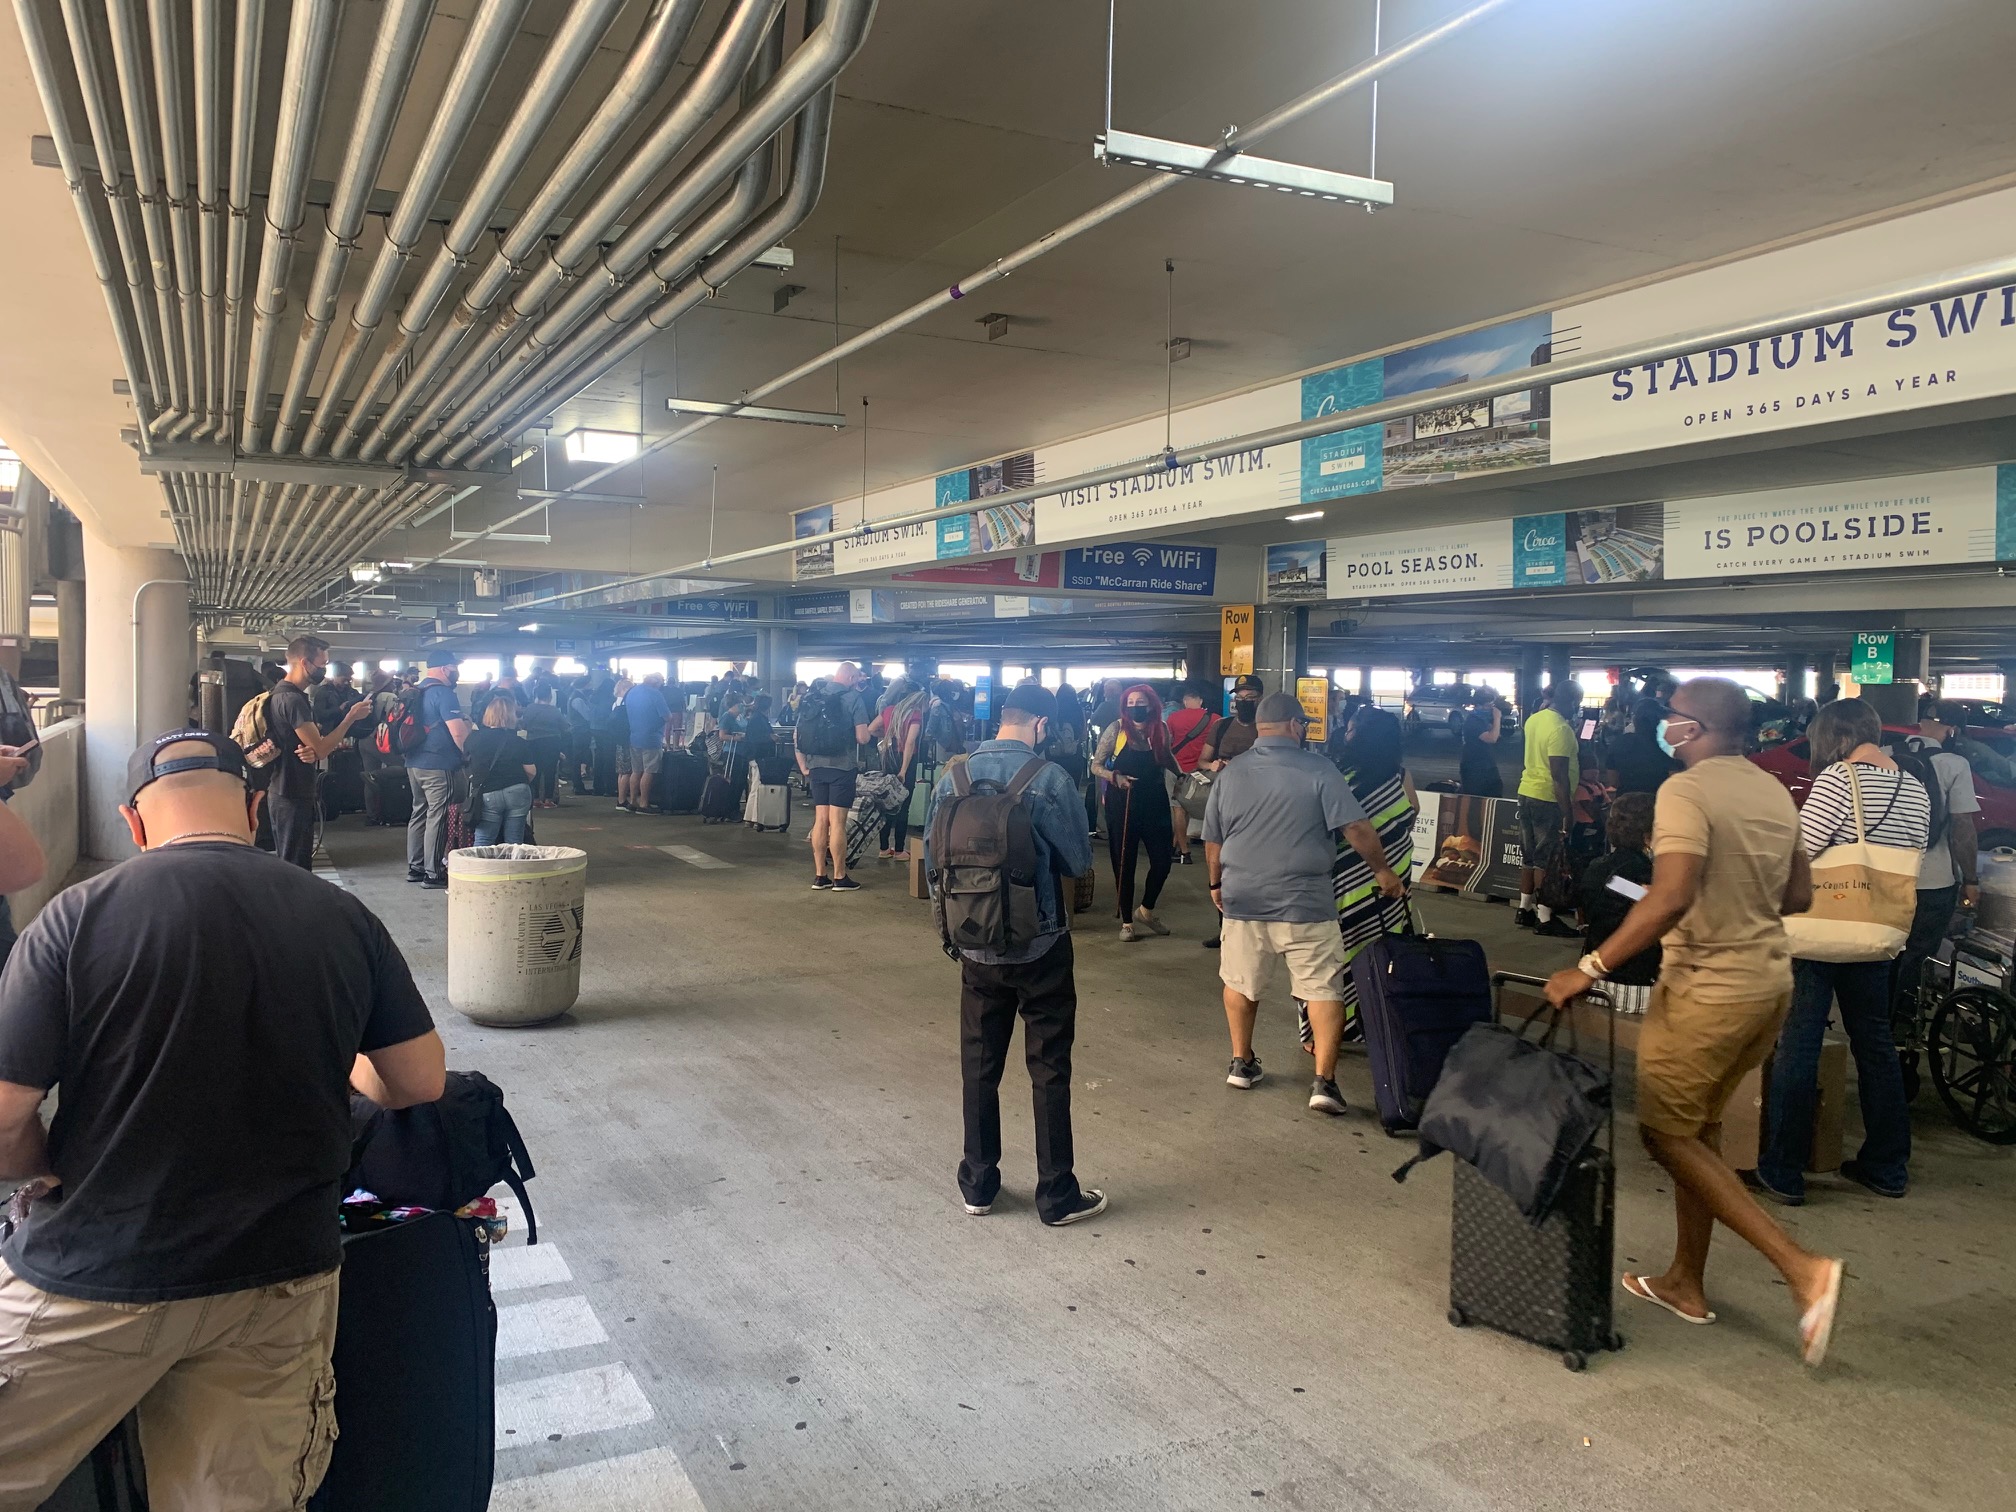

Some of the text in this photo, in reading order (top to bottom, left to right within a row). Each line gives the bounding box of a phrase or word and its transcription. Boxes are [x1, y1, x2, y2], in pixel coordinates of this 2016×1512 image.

[1611, 321, 1854, 401] STADIUM
[1684, 370, 1957, 427] OPEN 365 DAYS A YEAR
[1323, 446, 1363, 460] STADIUM
[1331, 460, 1354, 470] SWIM
[1060, 485, 1101, 508] VISIT
[1109, 463, 1193, 499] STADIUM
[1203, 448, 1271, 481] SWIM.
[1109, 513, 1128, 523] OPEN
[1131, 510, 1144, 519] 365
[1148, 506, 1168, 516] DAYS
[1182, 500, 1203, 511] YEAR
[1734, 512, 1756, 521] PLACE
[1772, 509, 1796, 517] WATCH
[1818, 505, 1839, 513] GAME
[1844, 502, 1869, 511] WHILE
[1874, 499, 1904, 508] YOU'RE
[1909, 496, 1931, 505] HERE
[845, 522, 928, 549] STADIUM SWIM.
[1704, 511, 1943, 550] IS POOLSIDE.
[1524, 529, 1558, 552] Circa
[1081, 546, 1201, 570] Free WiFi
[1789, 556, 1817, 564] GAME
[1842, 552, 1891, 561] STADIUM
[1899, 549, 1930, 557] SWIM
[1347, 552, 1484, 578] POOL SEASON.
[1071, 575, 1208, 591] SSID "McCarran Ride Share"
[677, 600, 750, 612] Free WiFi
[1225, 610, 1250, 625] Row
[1232, 627, 1241, 643] A
[1857, 632, 1889, 645] Row
[1867, 646, 1878, 659] B
[1862, 661, 1867, 670] 1
[1876, 661, 1882, 670] 2
[1861, 674, 1868, 683] 3
[1876, 674, 1882, 683] 7
[1852, 879, 1871, 891] LINE
[529, 903, 543, 911] LAS
[516, 913, 526, 969] CLARK COUNTY
